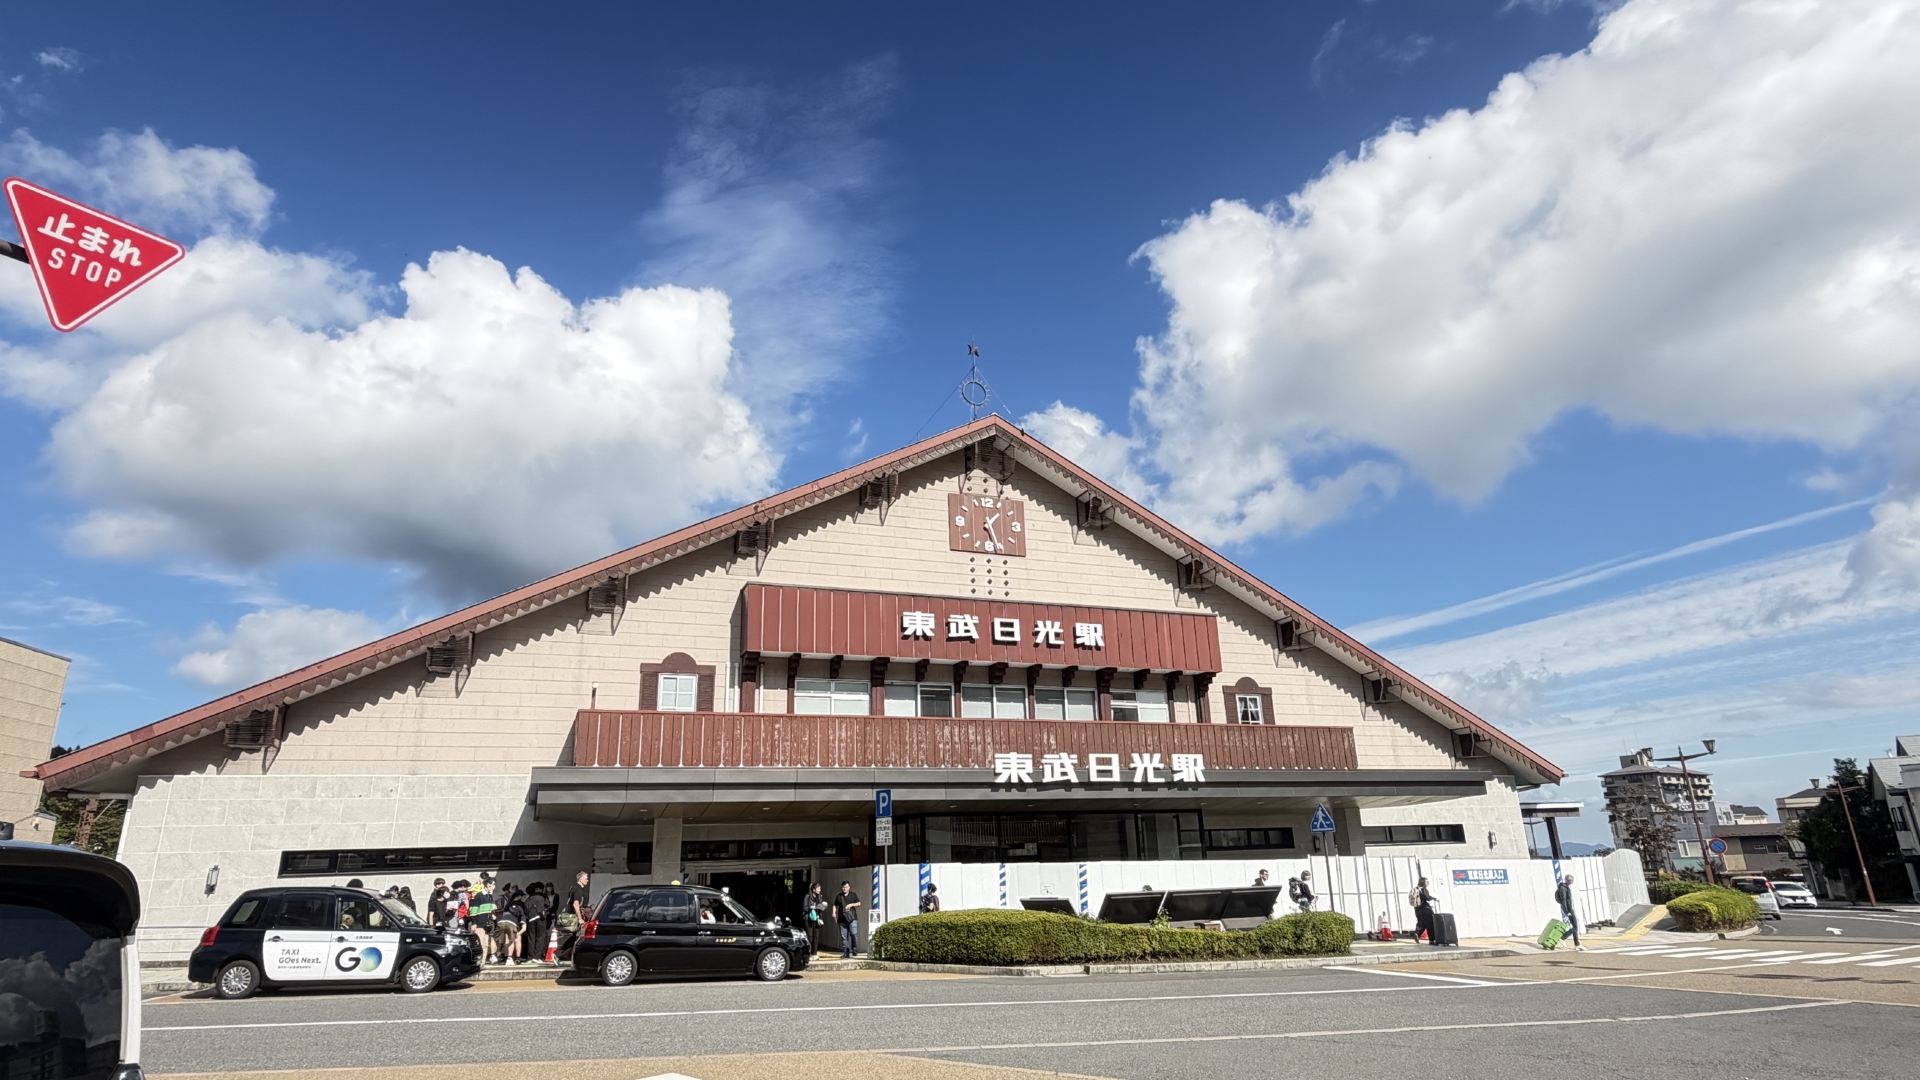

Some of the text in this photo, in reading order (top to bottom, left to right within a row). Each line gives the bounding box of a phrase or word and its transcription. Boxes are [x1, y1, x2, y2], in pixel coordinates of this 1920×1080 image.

[37, 213, 142, 267] 止まれ
[47, 247, 122, 288] STOP
[980, 497, 994, 508] 12
[955, 515, 966, 527] 9
[1011, 521, 1022, 532] 3
[984, 540, 994, 551] 6
[902, 611, 1105, 647] 東武日光駅
[994, 752, 1206, 783] 東武日光駅
[879, 792, 889, 815] P
